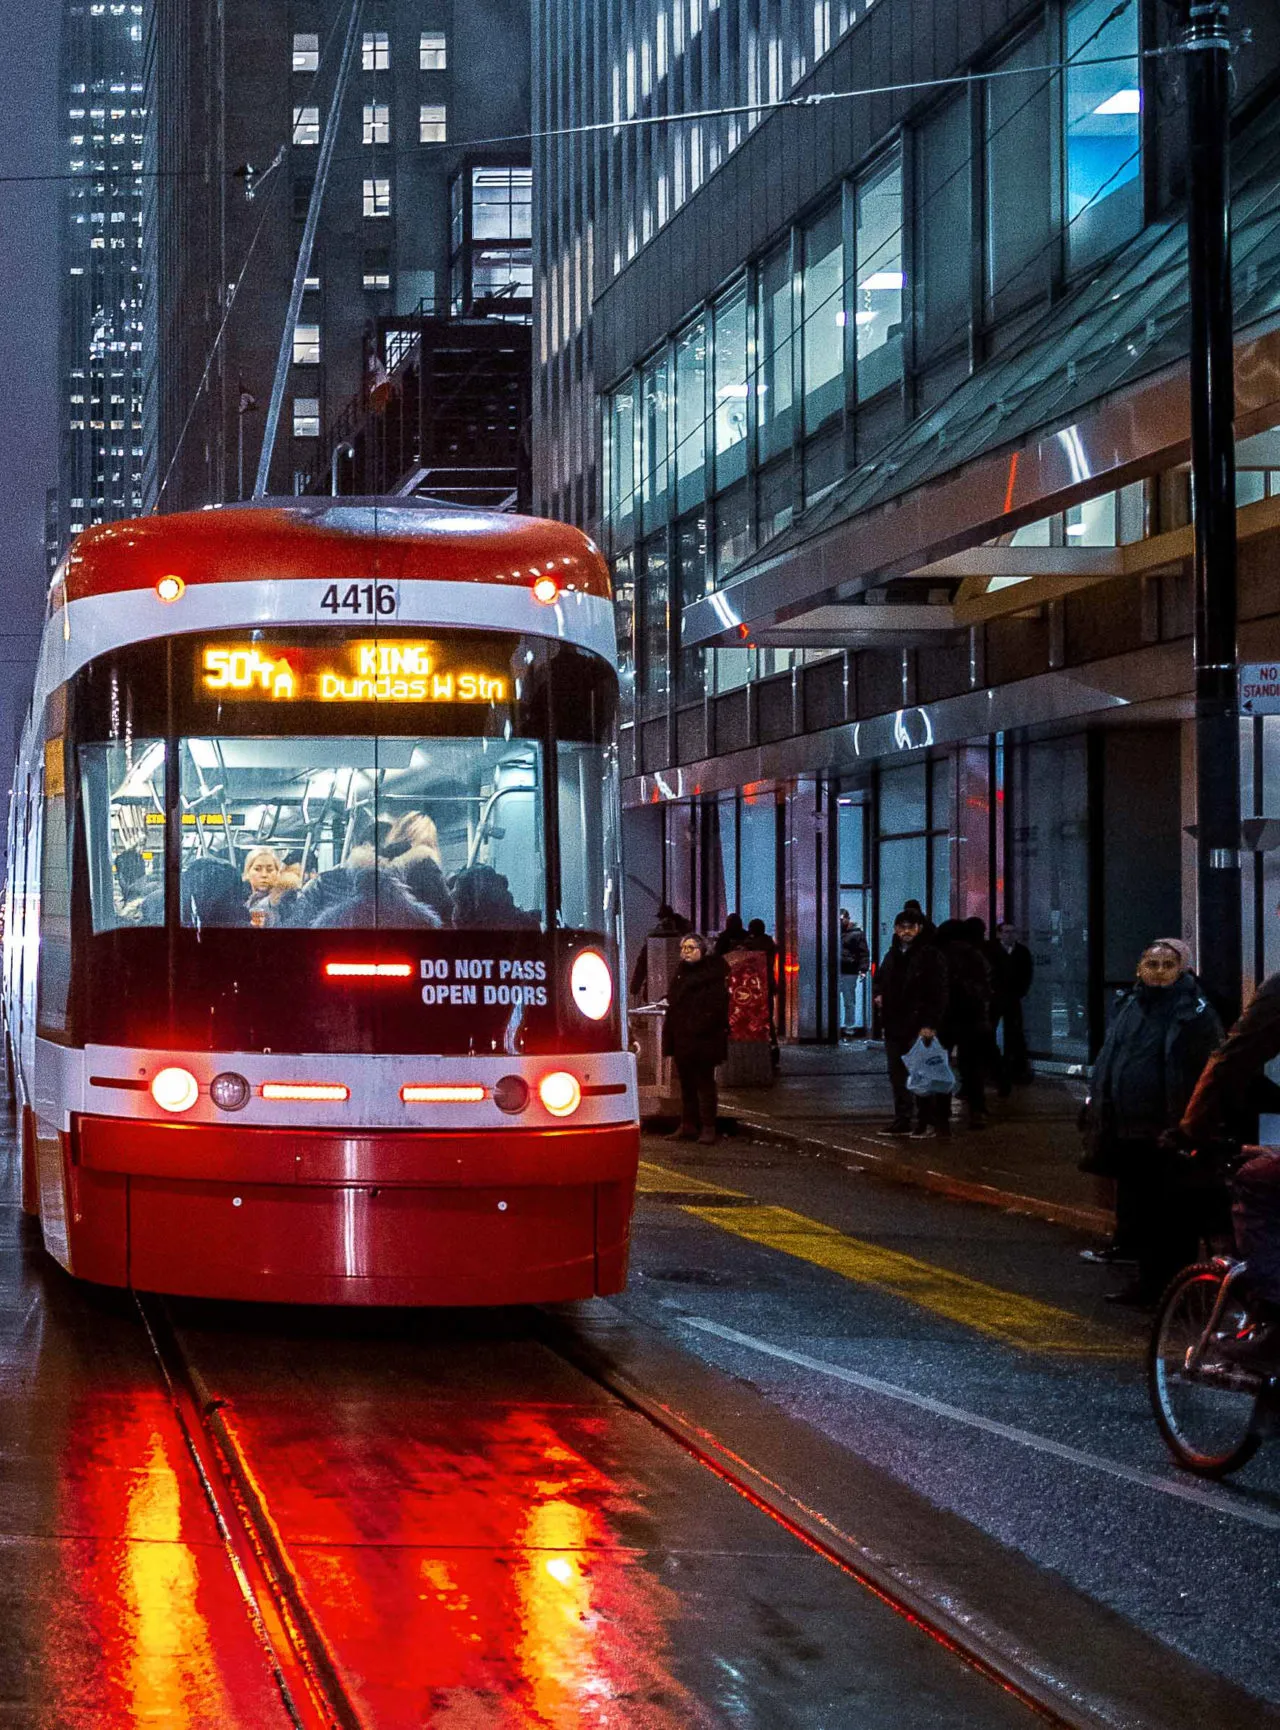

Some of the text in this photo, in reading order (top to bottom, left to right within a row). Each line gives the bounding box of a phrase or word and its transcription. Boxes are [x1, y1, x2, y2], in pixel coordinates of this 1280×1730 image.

[320, 583, 397, 615] 4416
[360, 647, 429, 675] KING
[1260, 667, 1278, 681] NO
[322, 675, 504, 699] Dundas W Stn
[420, 959, 547, 981] DO NOT PASS
[421, 984, 548, 1006] OPEN DOORS
